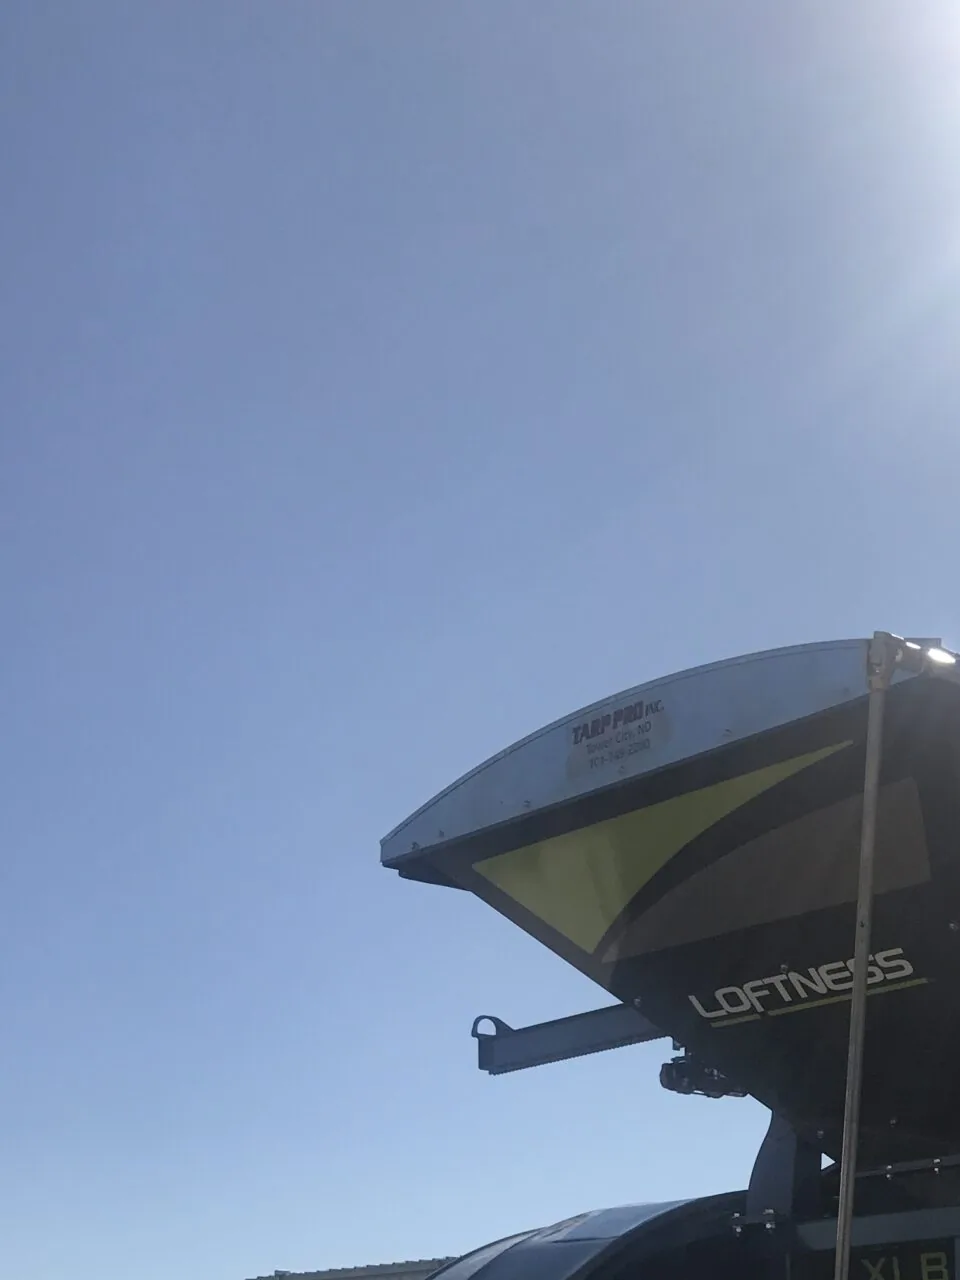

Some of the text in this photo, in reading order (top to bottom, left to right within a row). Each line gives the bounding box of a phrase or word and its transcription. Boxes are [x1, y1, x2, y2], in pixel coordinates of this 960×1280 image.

[572, 714, 611, 745] TARP
[612, 700, 644, 730] PRO
[688, 948, 914, 1018] LOFTNESS
